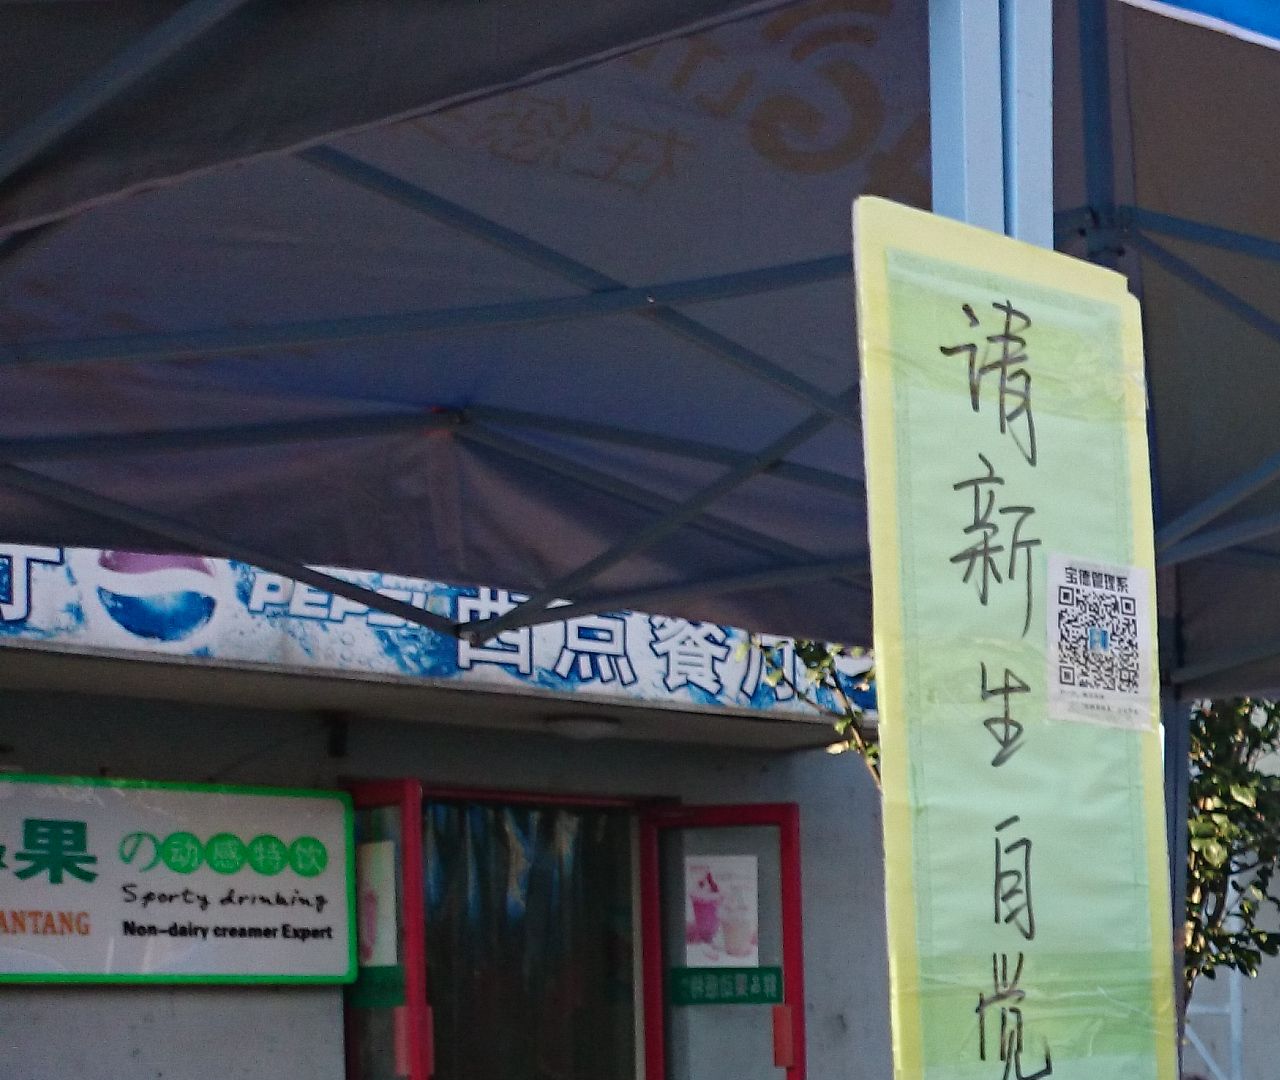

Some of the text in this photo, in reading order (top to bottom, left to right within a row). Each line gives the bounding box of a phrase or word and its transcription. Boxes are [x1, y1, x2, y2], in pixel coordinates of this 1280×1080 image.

[0, 818, 98, 884] 果
[121, 883, 209, 910] Sporty
[122, 920, 334, 942] Non-dairy creamer Expert
